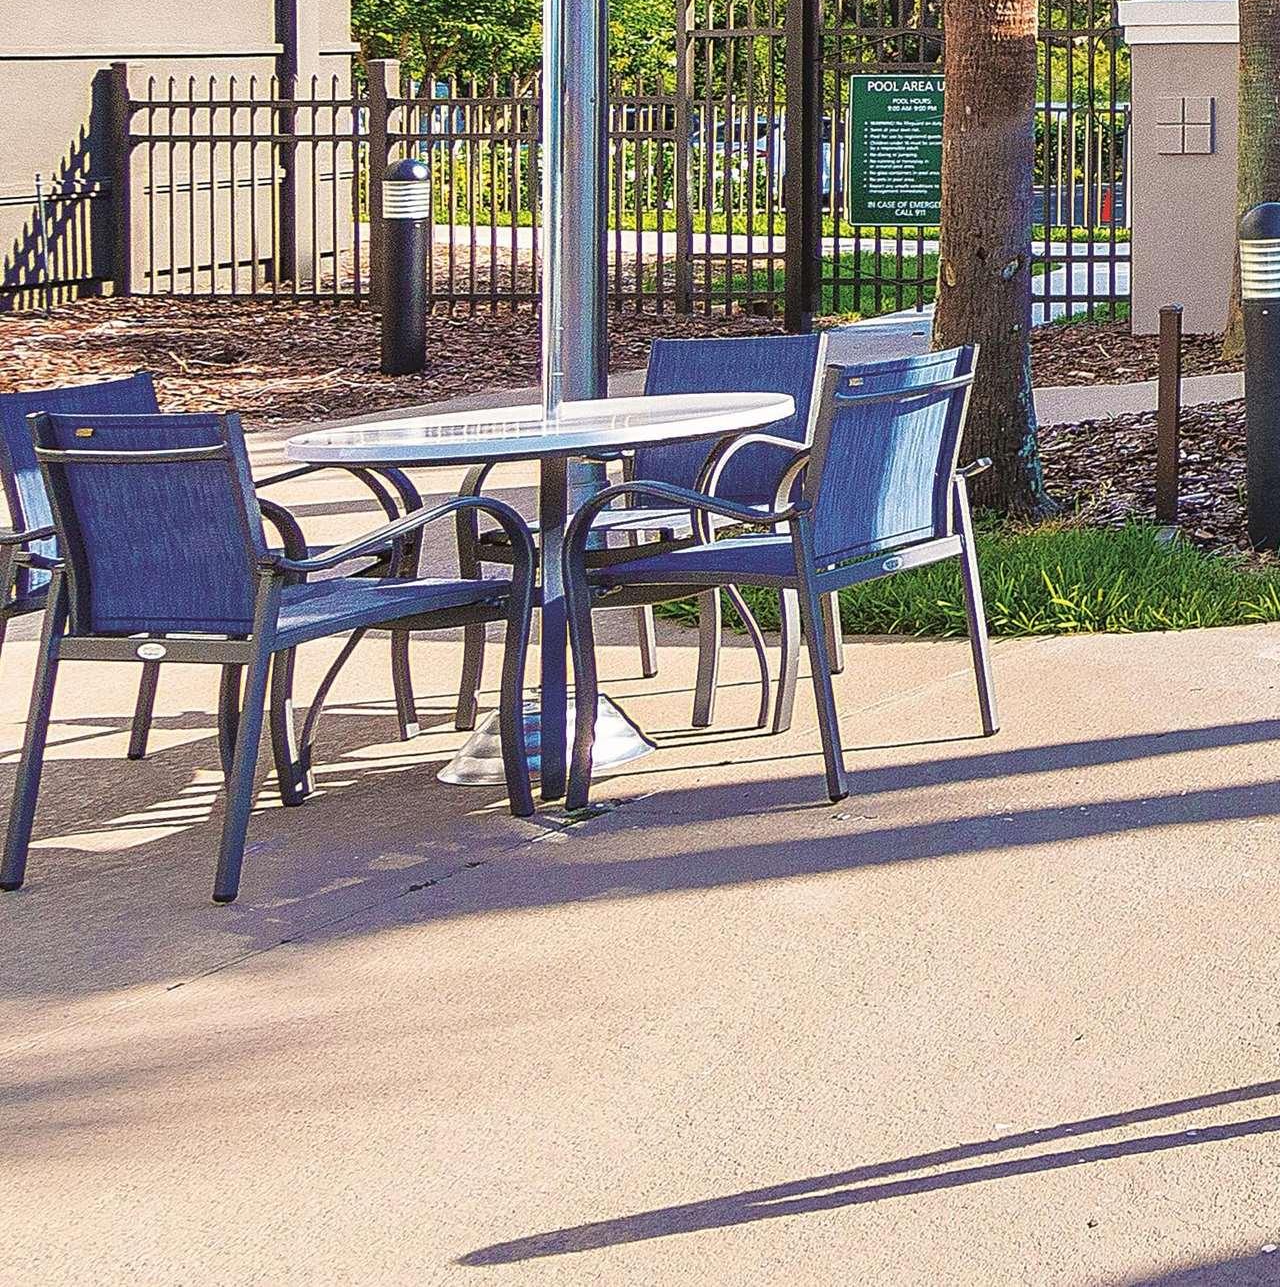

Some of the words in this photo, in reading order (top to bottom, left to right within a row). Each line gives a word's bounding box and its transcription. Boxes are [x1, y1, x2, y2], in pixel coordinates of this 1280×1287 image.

[868, 81, 900, 91] POOL
[902, 81, 934, 91] AREA
[897, 201, 907, 209] OF
[909, 201, 941, 209] EMERGE
